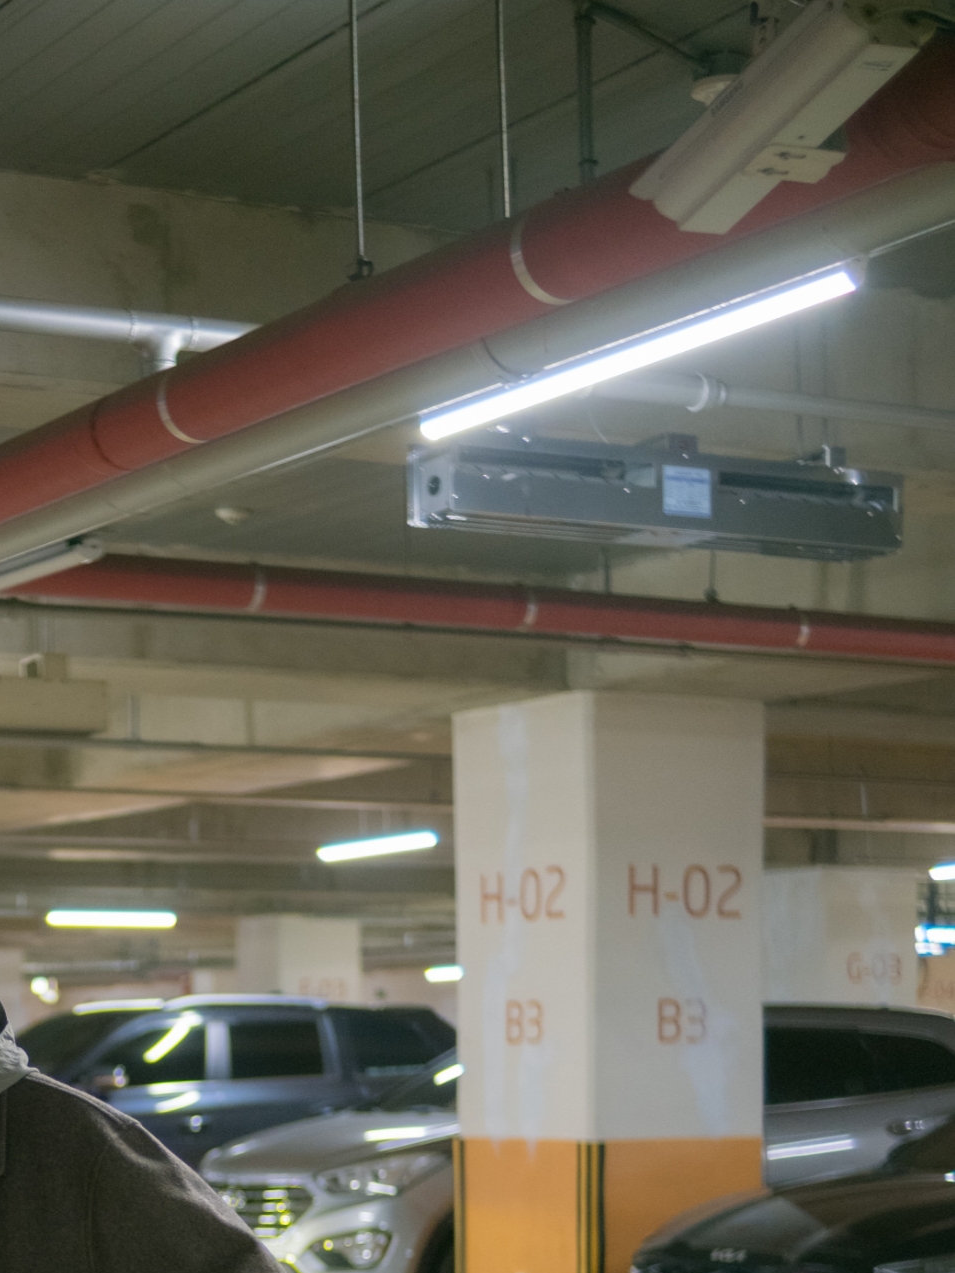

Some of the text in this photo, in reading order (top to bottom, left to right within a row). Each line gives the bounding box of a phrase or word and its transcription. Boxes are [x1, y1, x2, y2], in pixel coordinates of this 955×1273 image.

[479, 865, 566, 924] H-02
[626, 862, 743, 920] H-02
[505, 999, 543, 1046] B3
[657, 997, 707, 1045] B3
